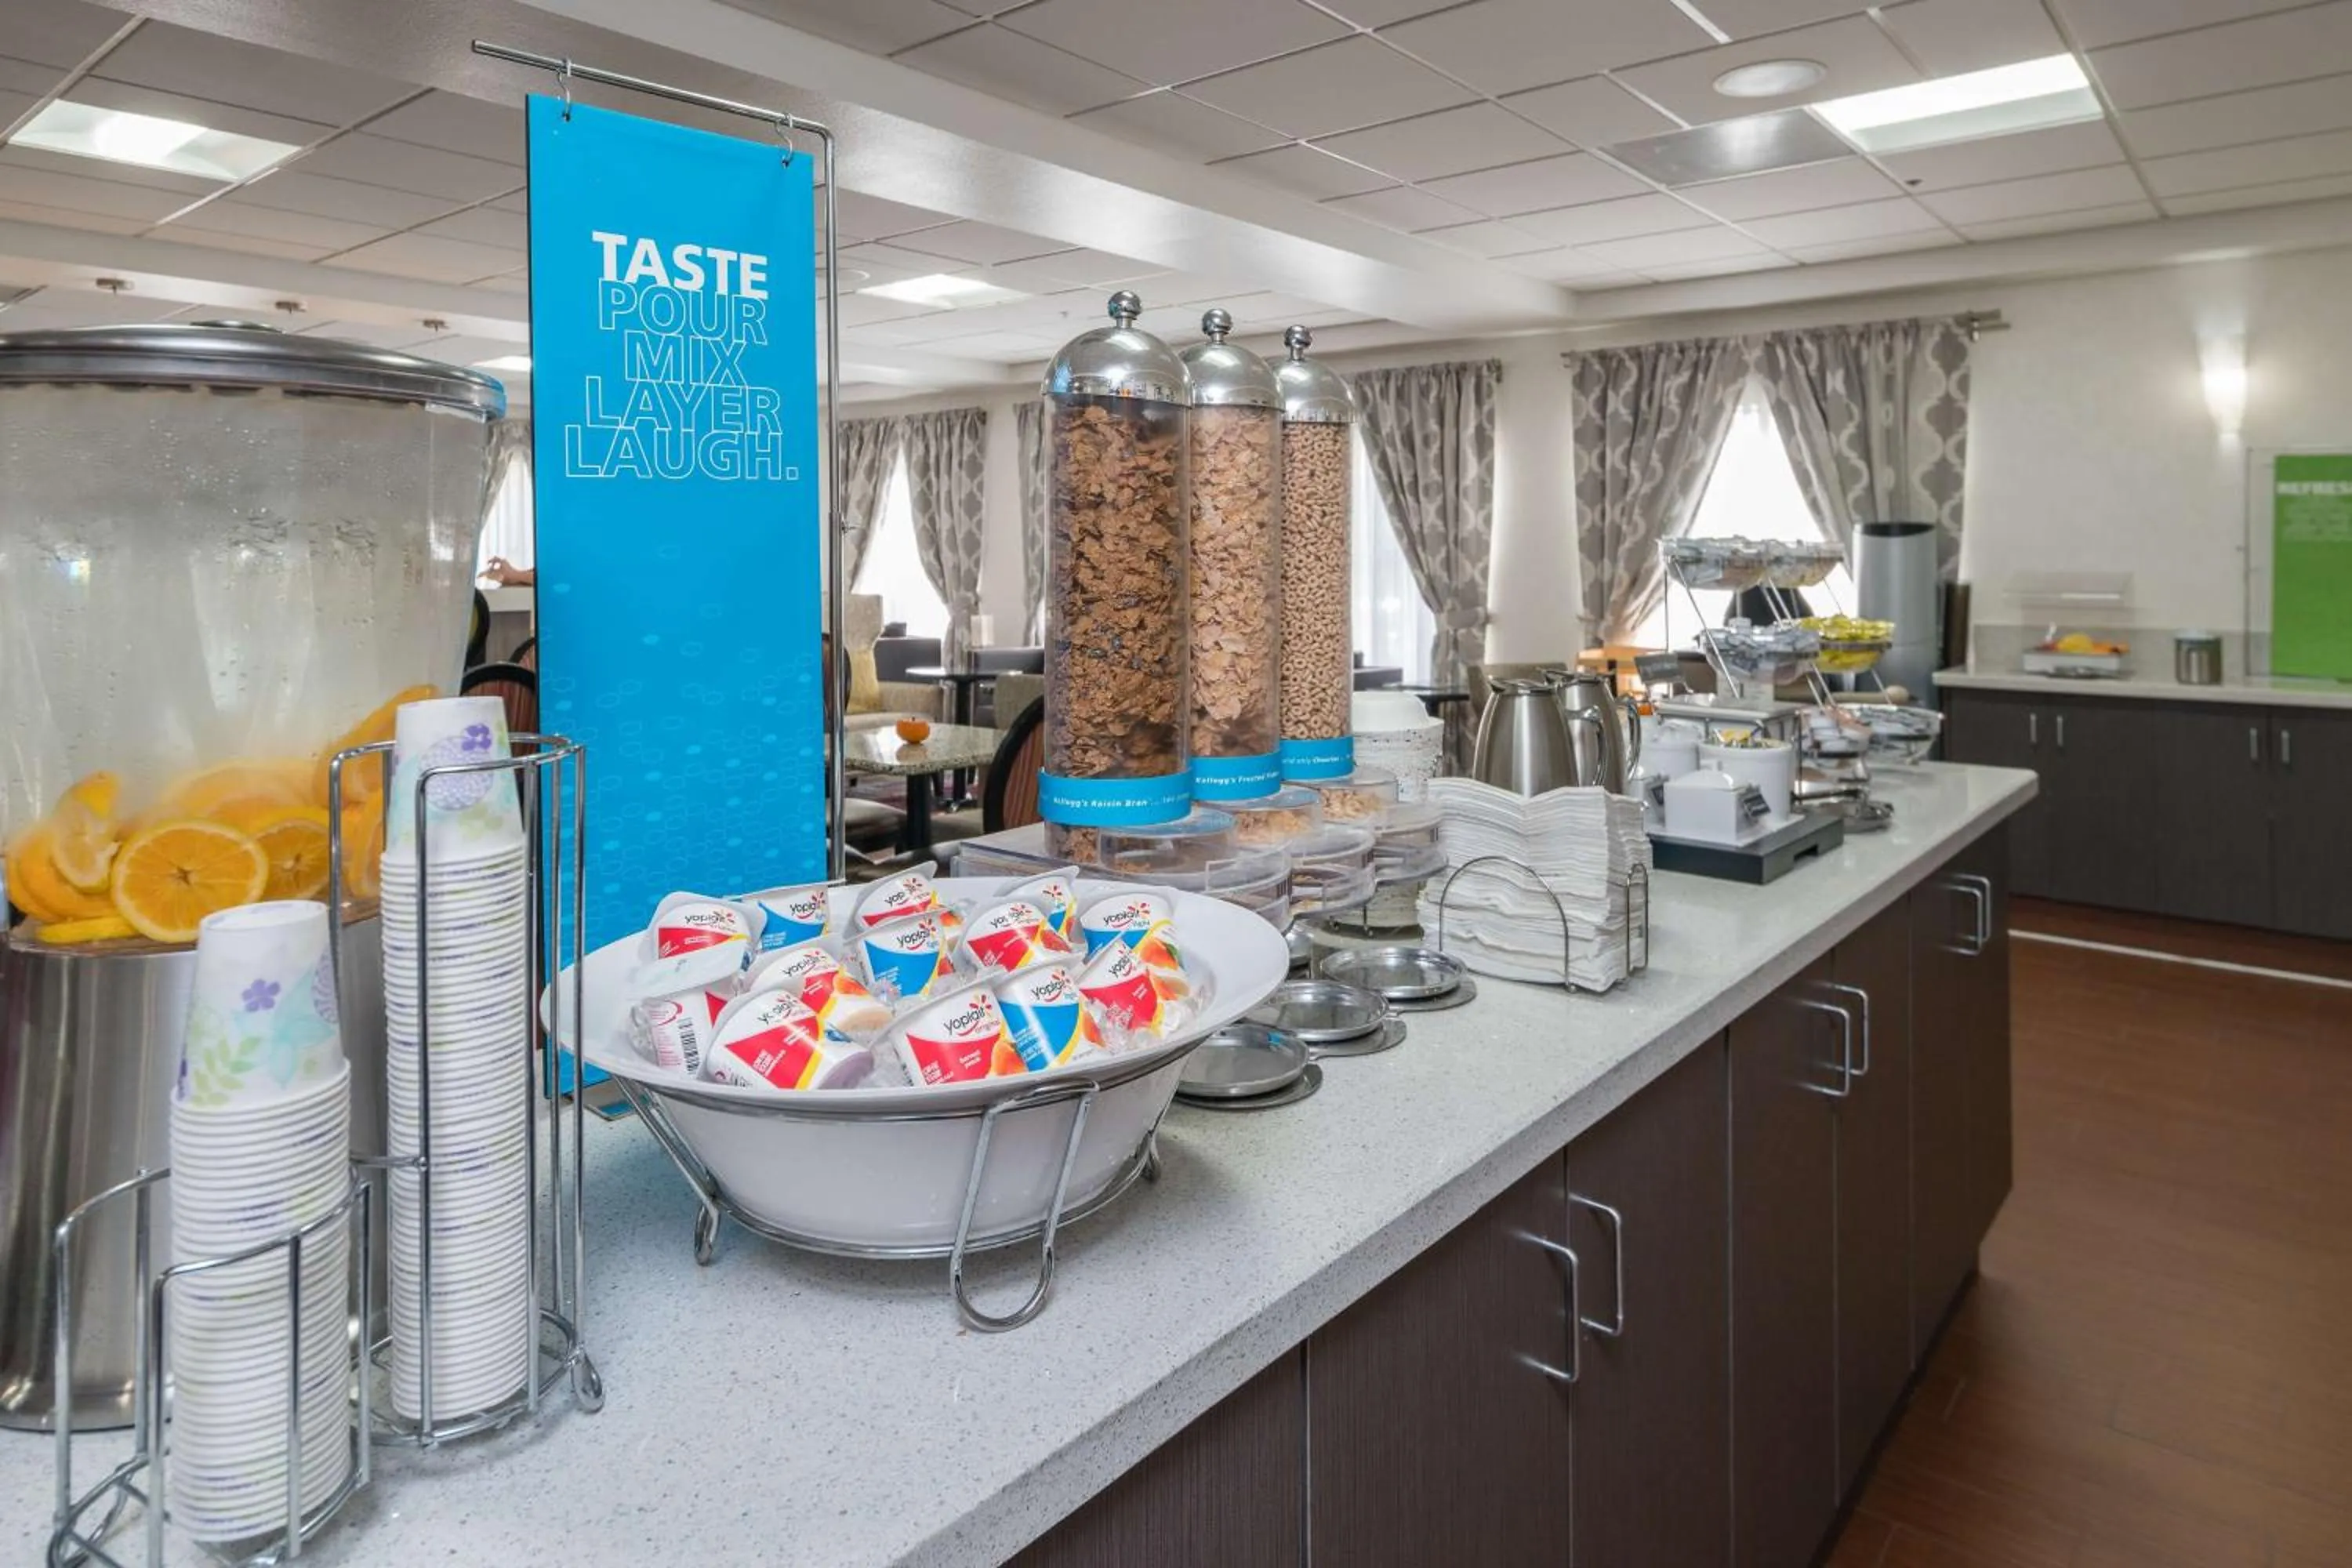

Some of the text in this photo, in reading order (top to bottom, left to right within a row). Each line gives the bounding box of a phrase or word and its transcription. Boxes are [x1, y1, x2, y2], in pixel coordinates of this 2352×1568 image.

[592, 230, 769, 299] TASTE
[598, 278, 768, 345] POUR
[624, 329, 746, 387] MIX
[586, 376, 783, 435] LAYER
[564, 424, 799, 481] LAUGH.
[1053, 796, 1088, 808] Kellogg's
[1091, 799, 1122, 809] Raisin
[1125, 799, 1148, 808] Bran
[1195, 776, 1236, 786] Kellogg's
